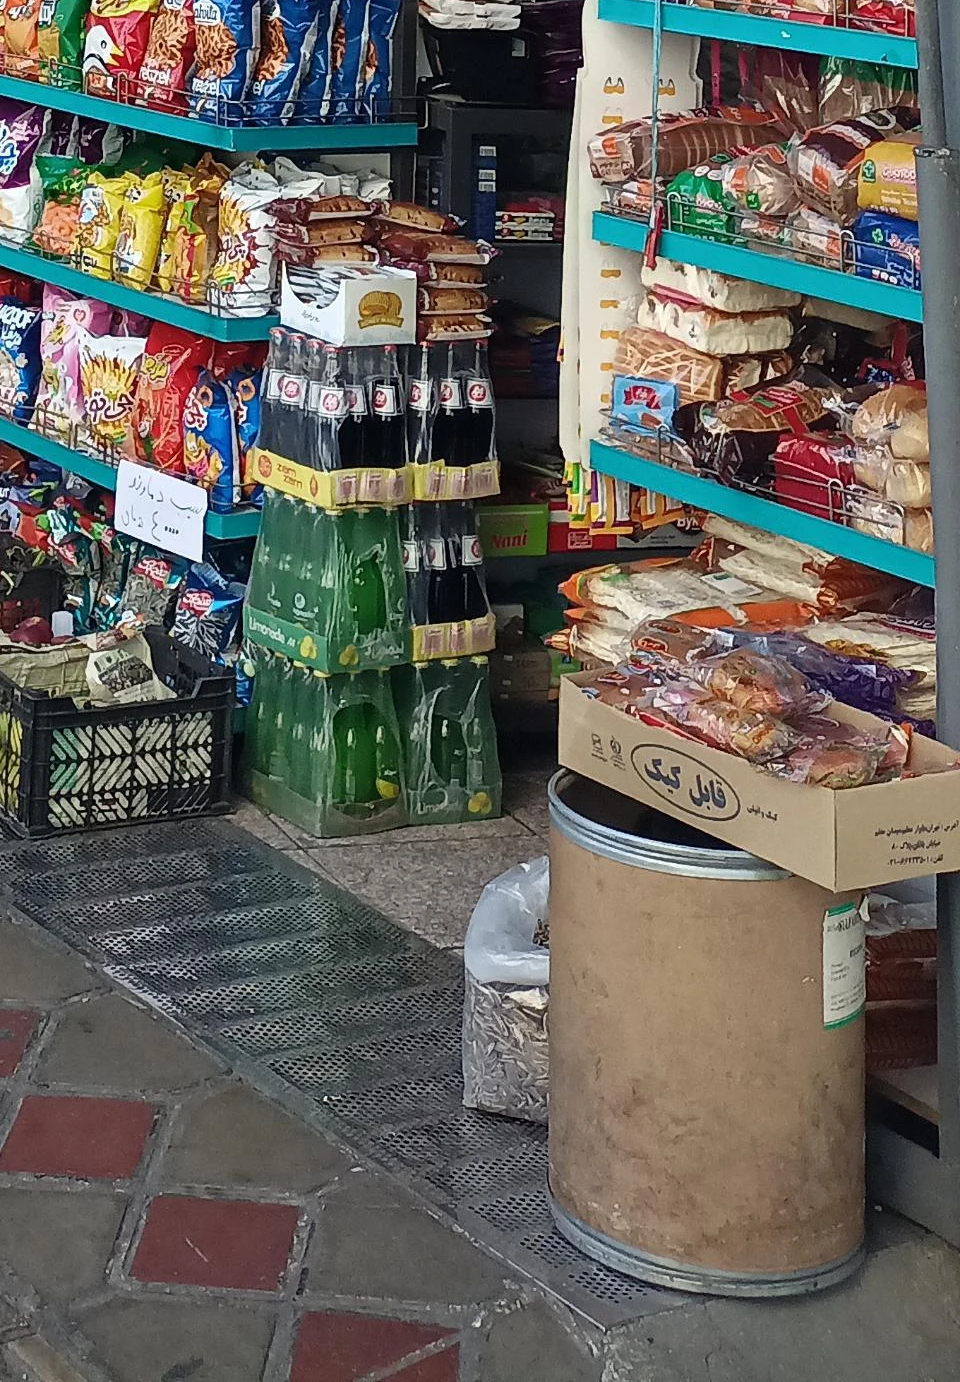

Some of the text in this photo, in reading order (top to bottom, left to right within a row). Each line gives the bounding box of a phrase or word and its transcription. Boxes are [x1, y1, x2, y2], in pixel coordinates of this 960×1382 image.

[139, 66, 171, 86] retzel
[192, 77, 220, 95] retzel
[170, 497, 202, 519] سیب
[643, 758, 727, 811] قابل کیک
